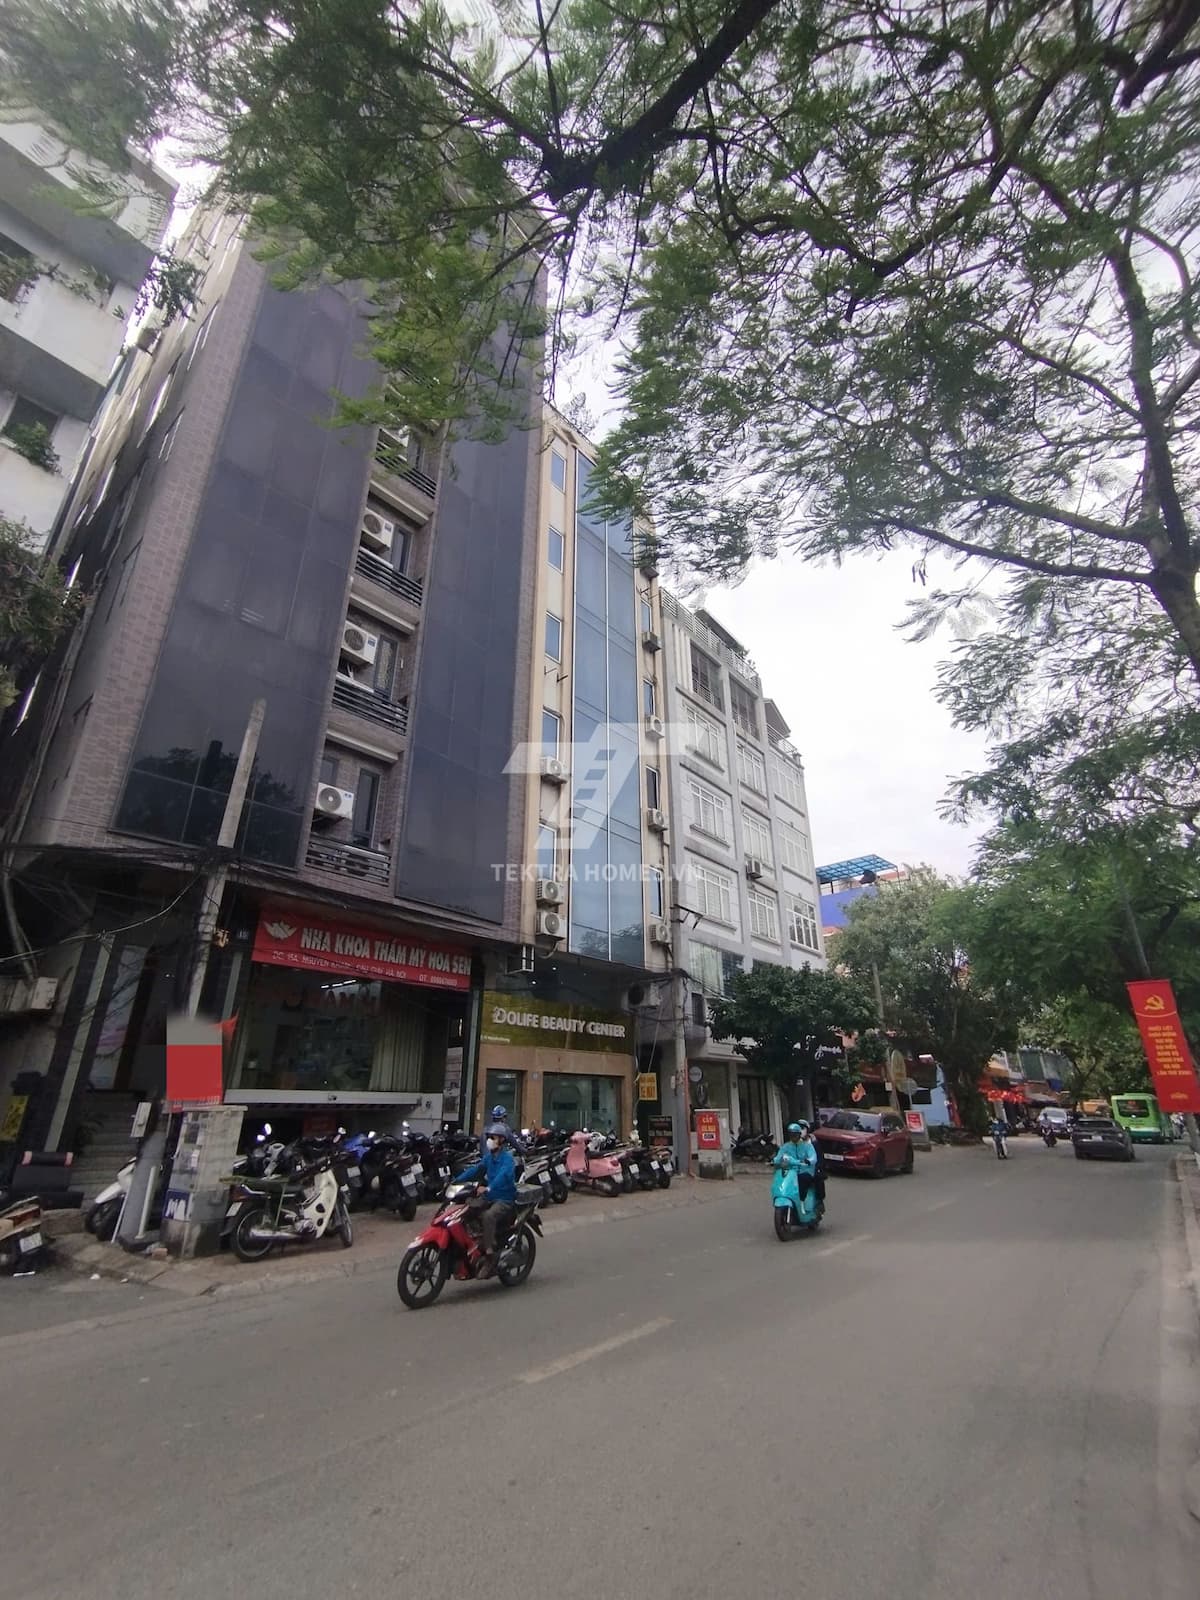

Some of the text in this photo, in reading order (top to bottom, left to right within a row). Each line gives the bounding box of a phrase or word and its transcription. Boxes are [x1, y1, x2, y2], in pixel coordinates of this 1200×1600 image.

[301, 927, 331, 953] NHA
[334, 933, 370, 959] KHOA
[428, 951, 450, 973] HOA
[451, 955, 472, 976] SEN
[540, 1015, 586, 1034] BEAUTY
[586, 1020, 626, 1038] CENTER
